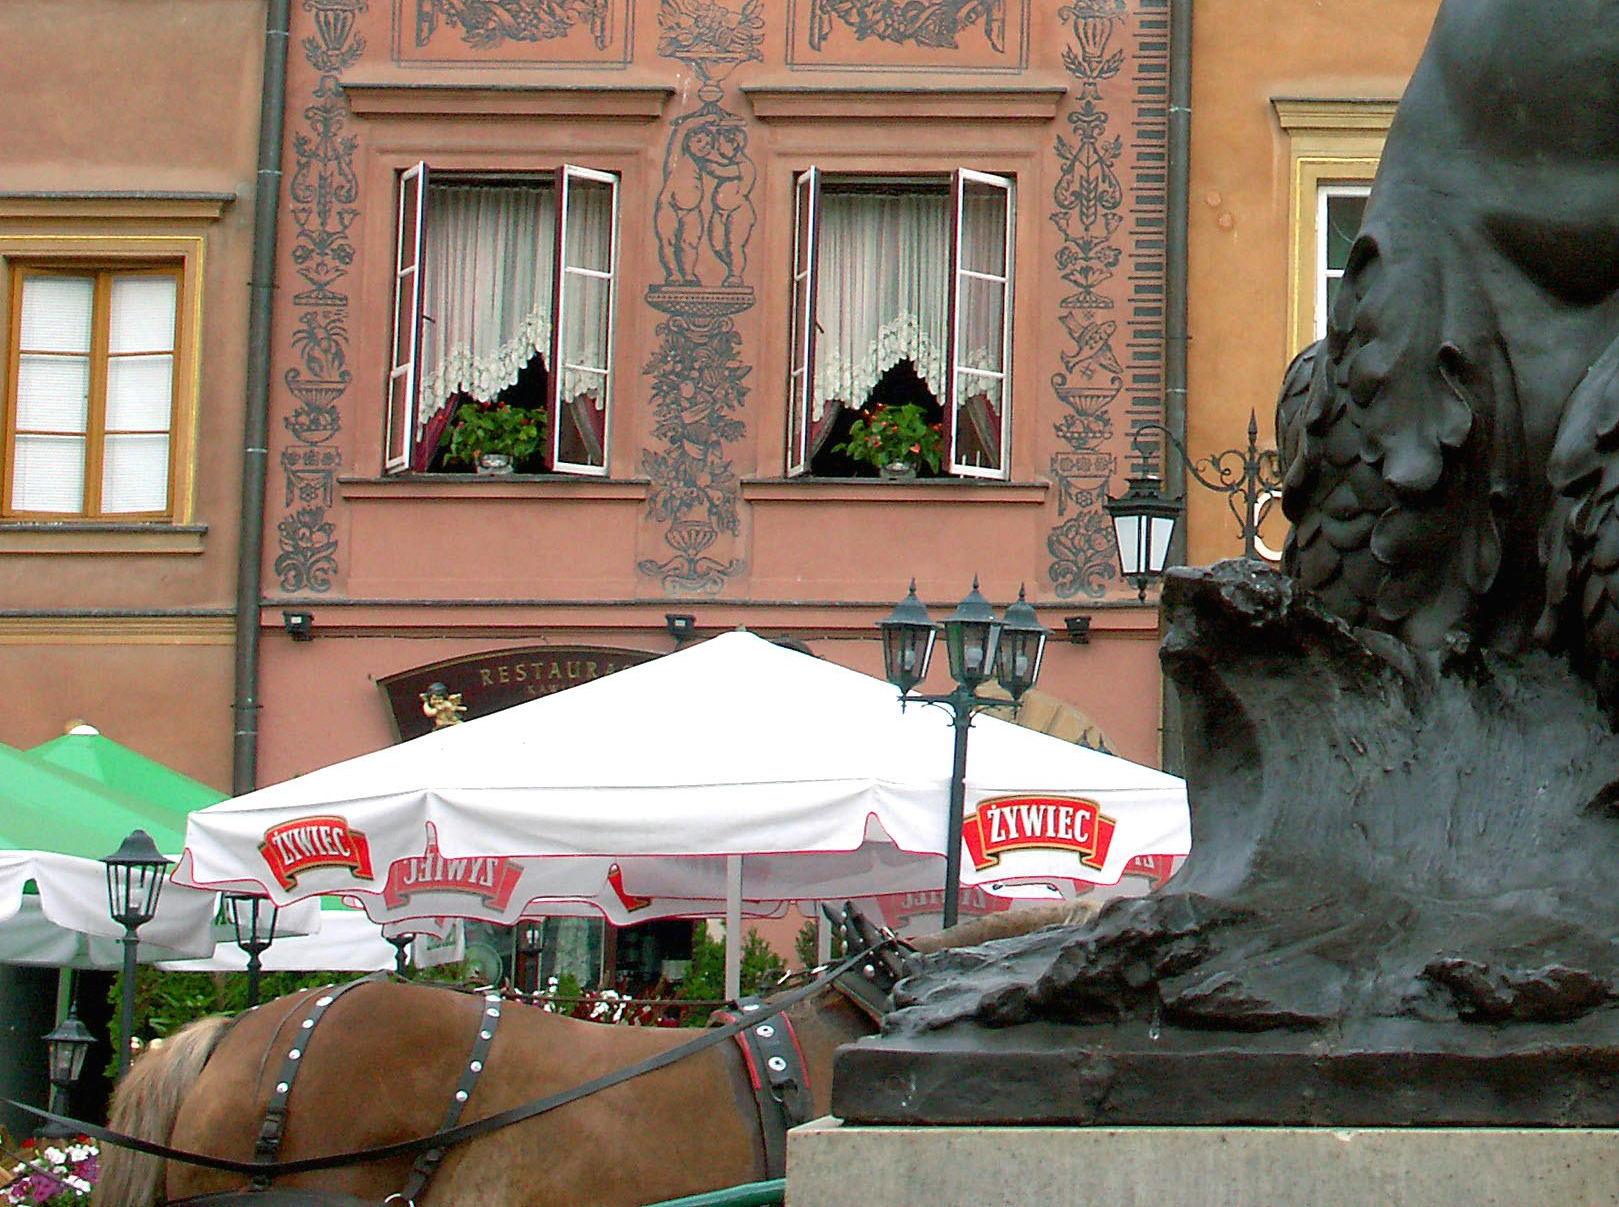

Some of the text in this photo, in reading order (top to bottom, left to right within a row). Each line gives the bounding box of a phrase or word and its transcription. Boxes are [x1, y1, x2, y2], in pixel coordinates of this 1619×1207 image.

[479, 661, 633, 687] RESTAURA
[986, 804, 1091, 843] ŻYWIEC
[271, 825, 351, 866] ŻYWIEC
